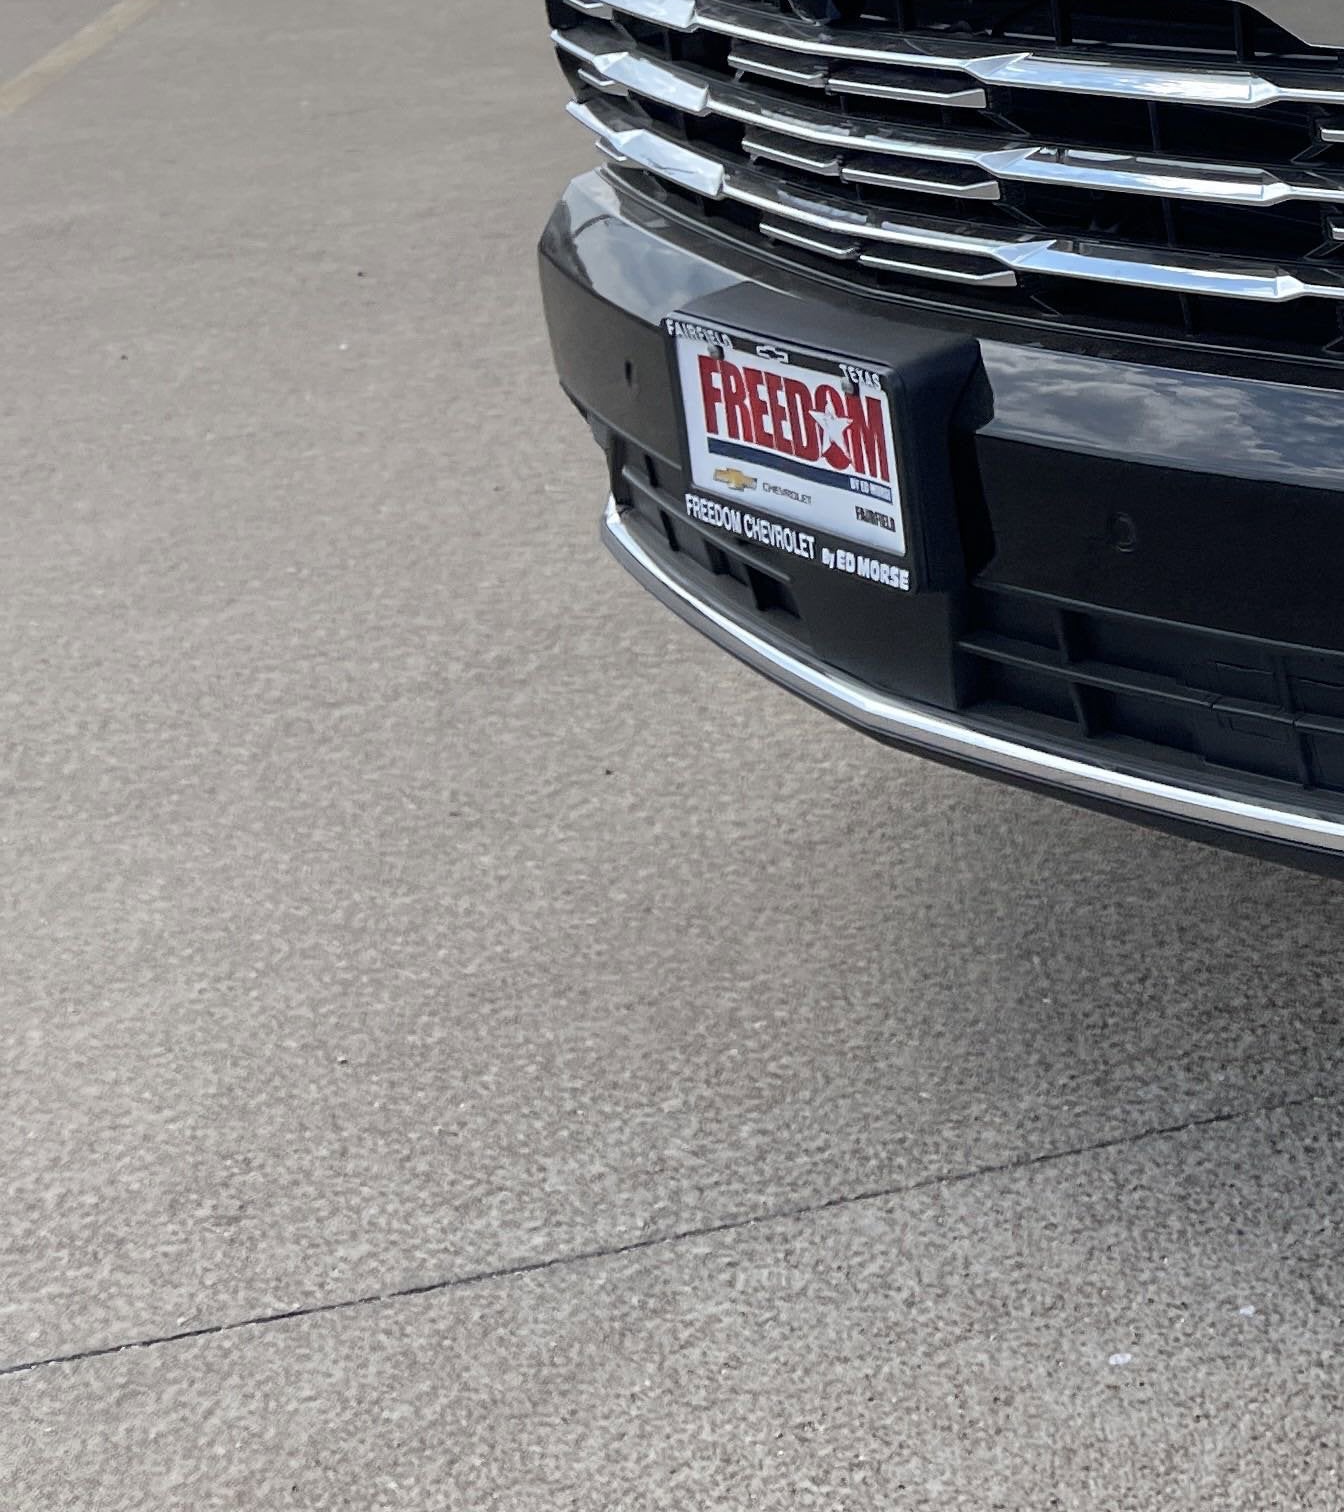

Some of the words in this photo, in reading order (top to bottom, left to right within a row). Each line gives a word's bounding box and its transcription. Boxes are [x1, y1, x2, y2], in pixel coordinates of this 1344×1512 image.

[665, 318, 733, 350] FAIRFIELD
[839, 363, 882, 390] TEXAS
[697, 354, 890, 483] FREEDOM
[762, 482, 811, 505] CHEVROLET
[685, 493, 743, 535] FREEDOM
[743, 513, 816, 560] CHEVROLET
[836, 548, 856, 574] ED
[857, 555, 910, 591] MORSE
